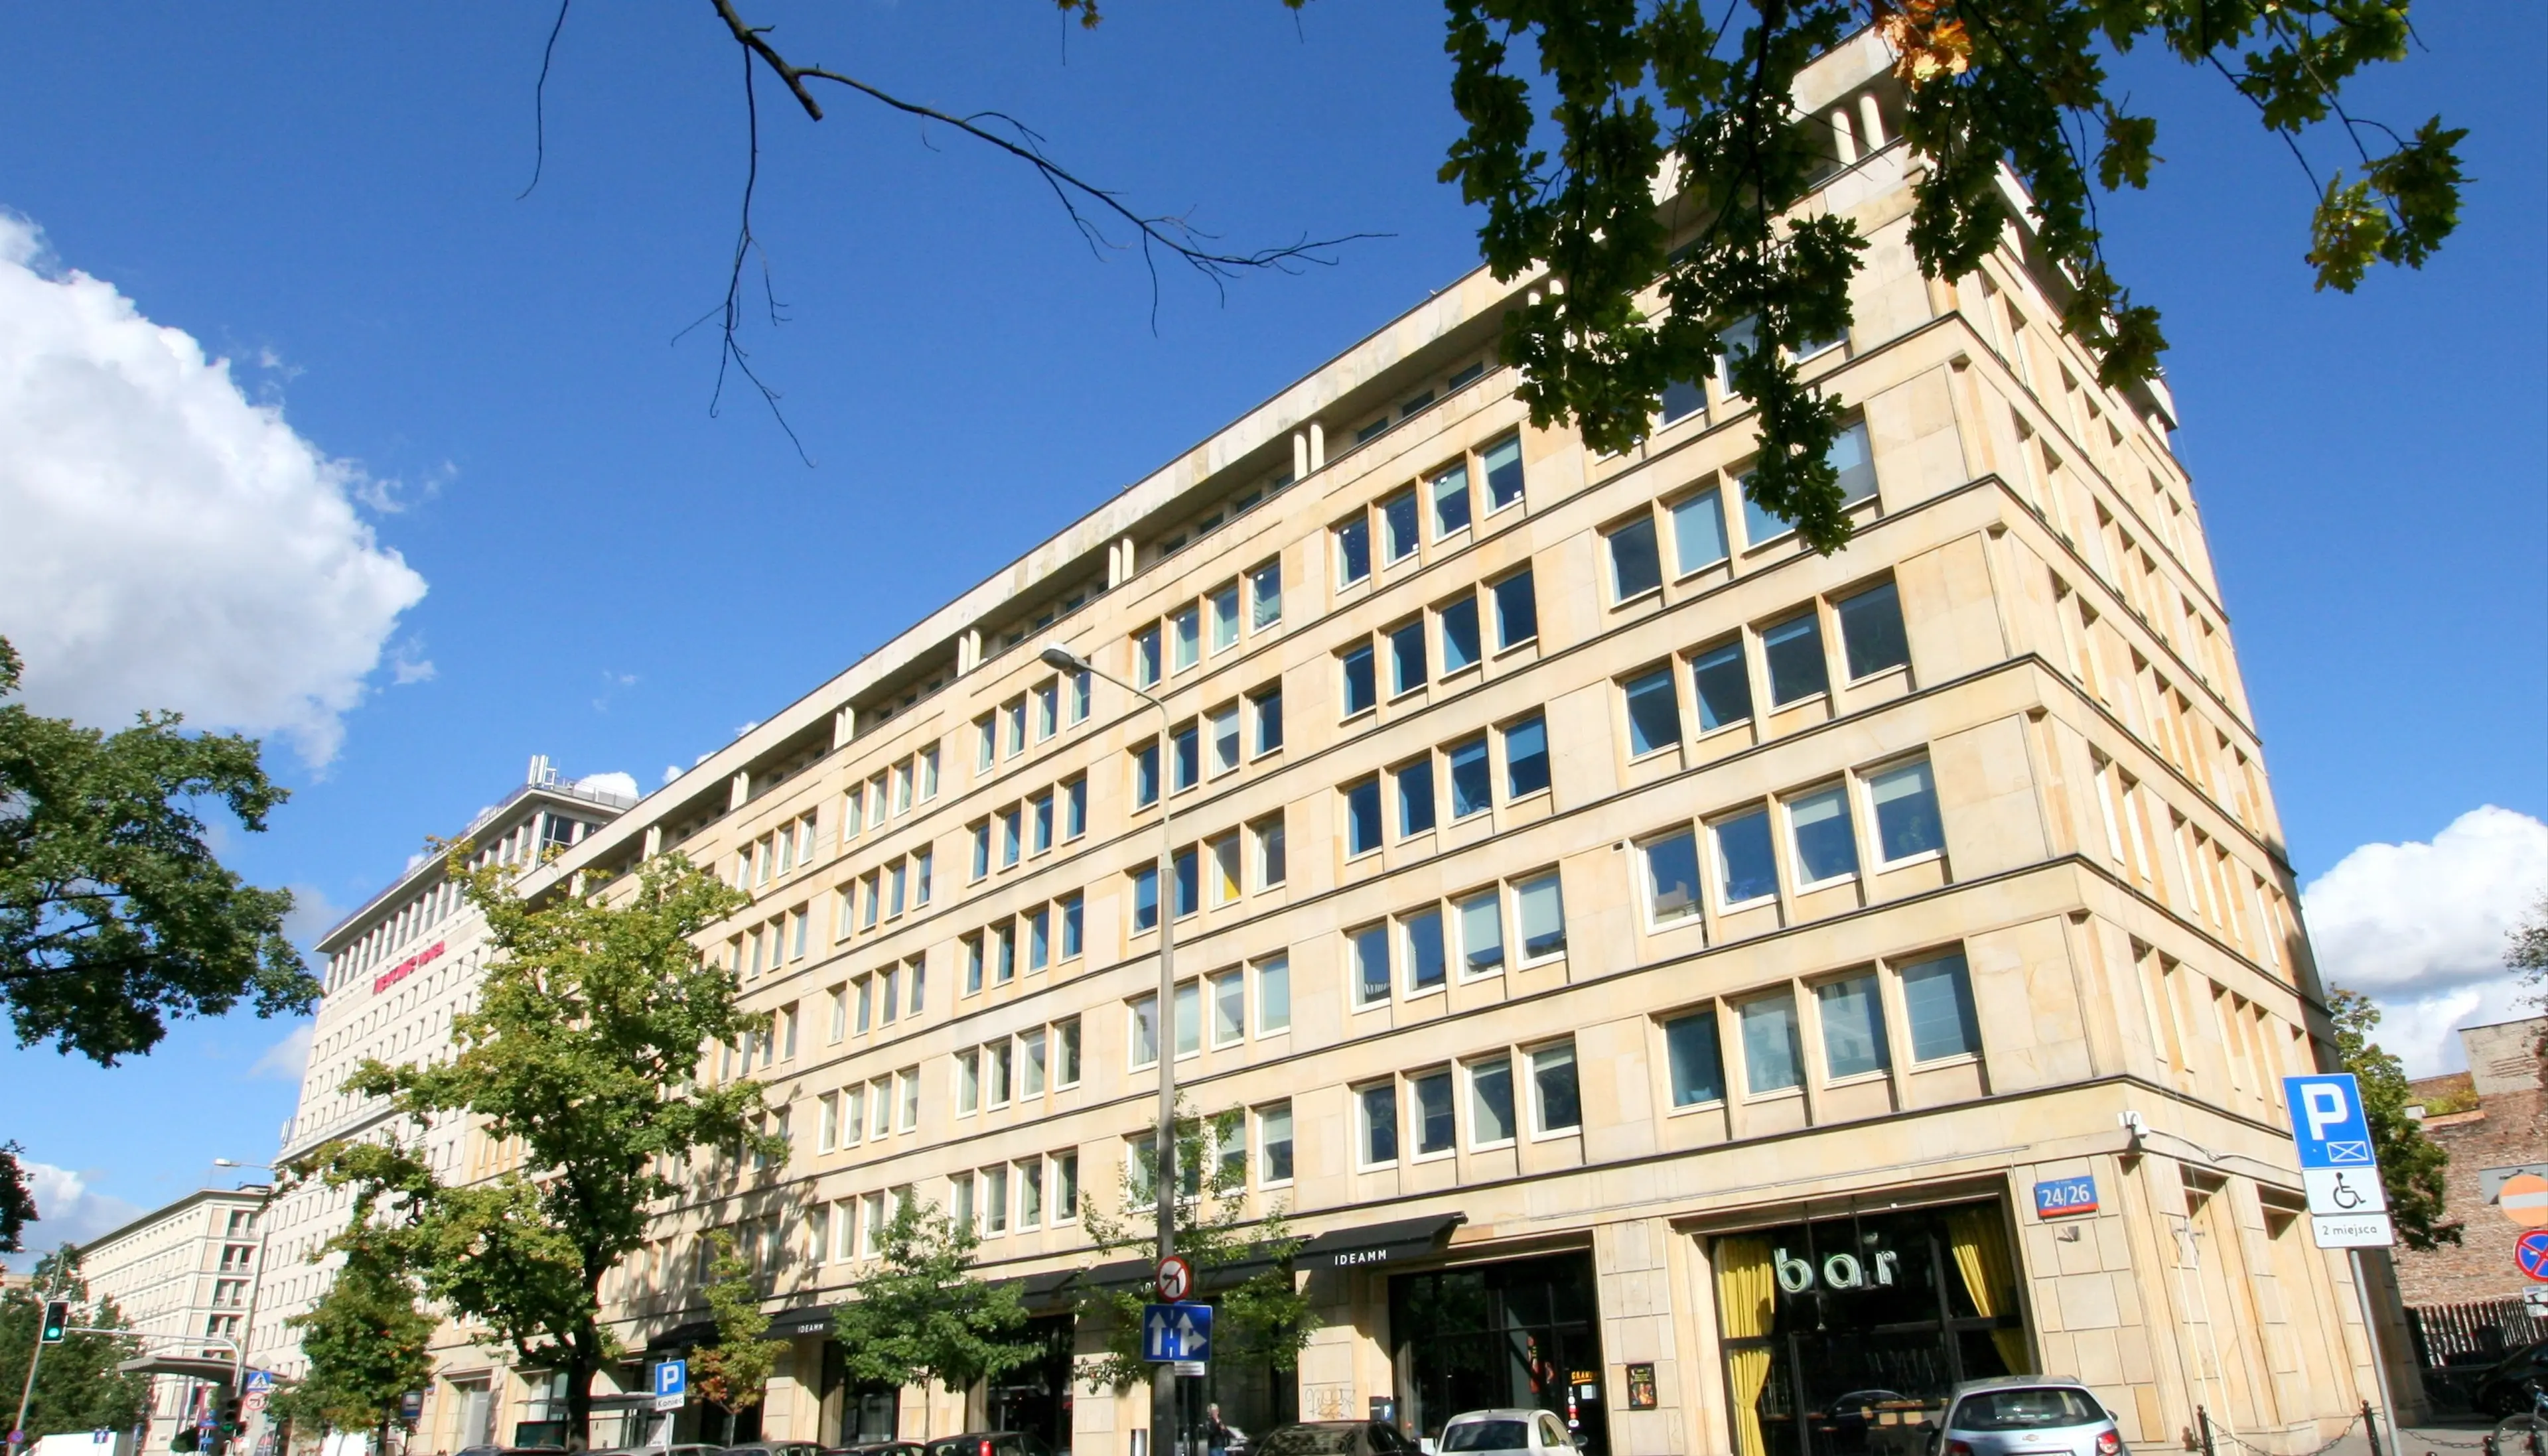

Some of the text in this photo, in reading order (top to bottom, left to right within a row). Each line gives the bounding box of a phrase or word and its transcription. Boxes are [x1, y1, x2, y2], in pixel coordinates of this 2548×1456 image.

[2300, 1083, 2348, 1140] P
[2042, 1184, 2090, 1207] 24/26
[2323, 1224, 2377, 1237] 2 miejsca
[1334, 1250, 1387, 1266] IDEAMM
[1774, 1248, 1897, 1293] bar
[662, 1365, 679, 1392] P
[658, 1397, 683, 1408] Koniec
